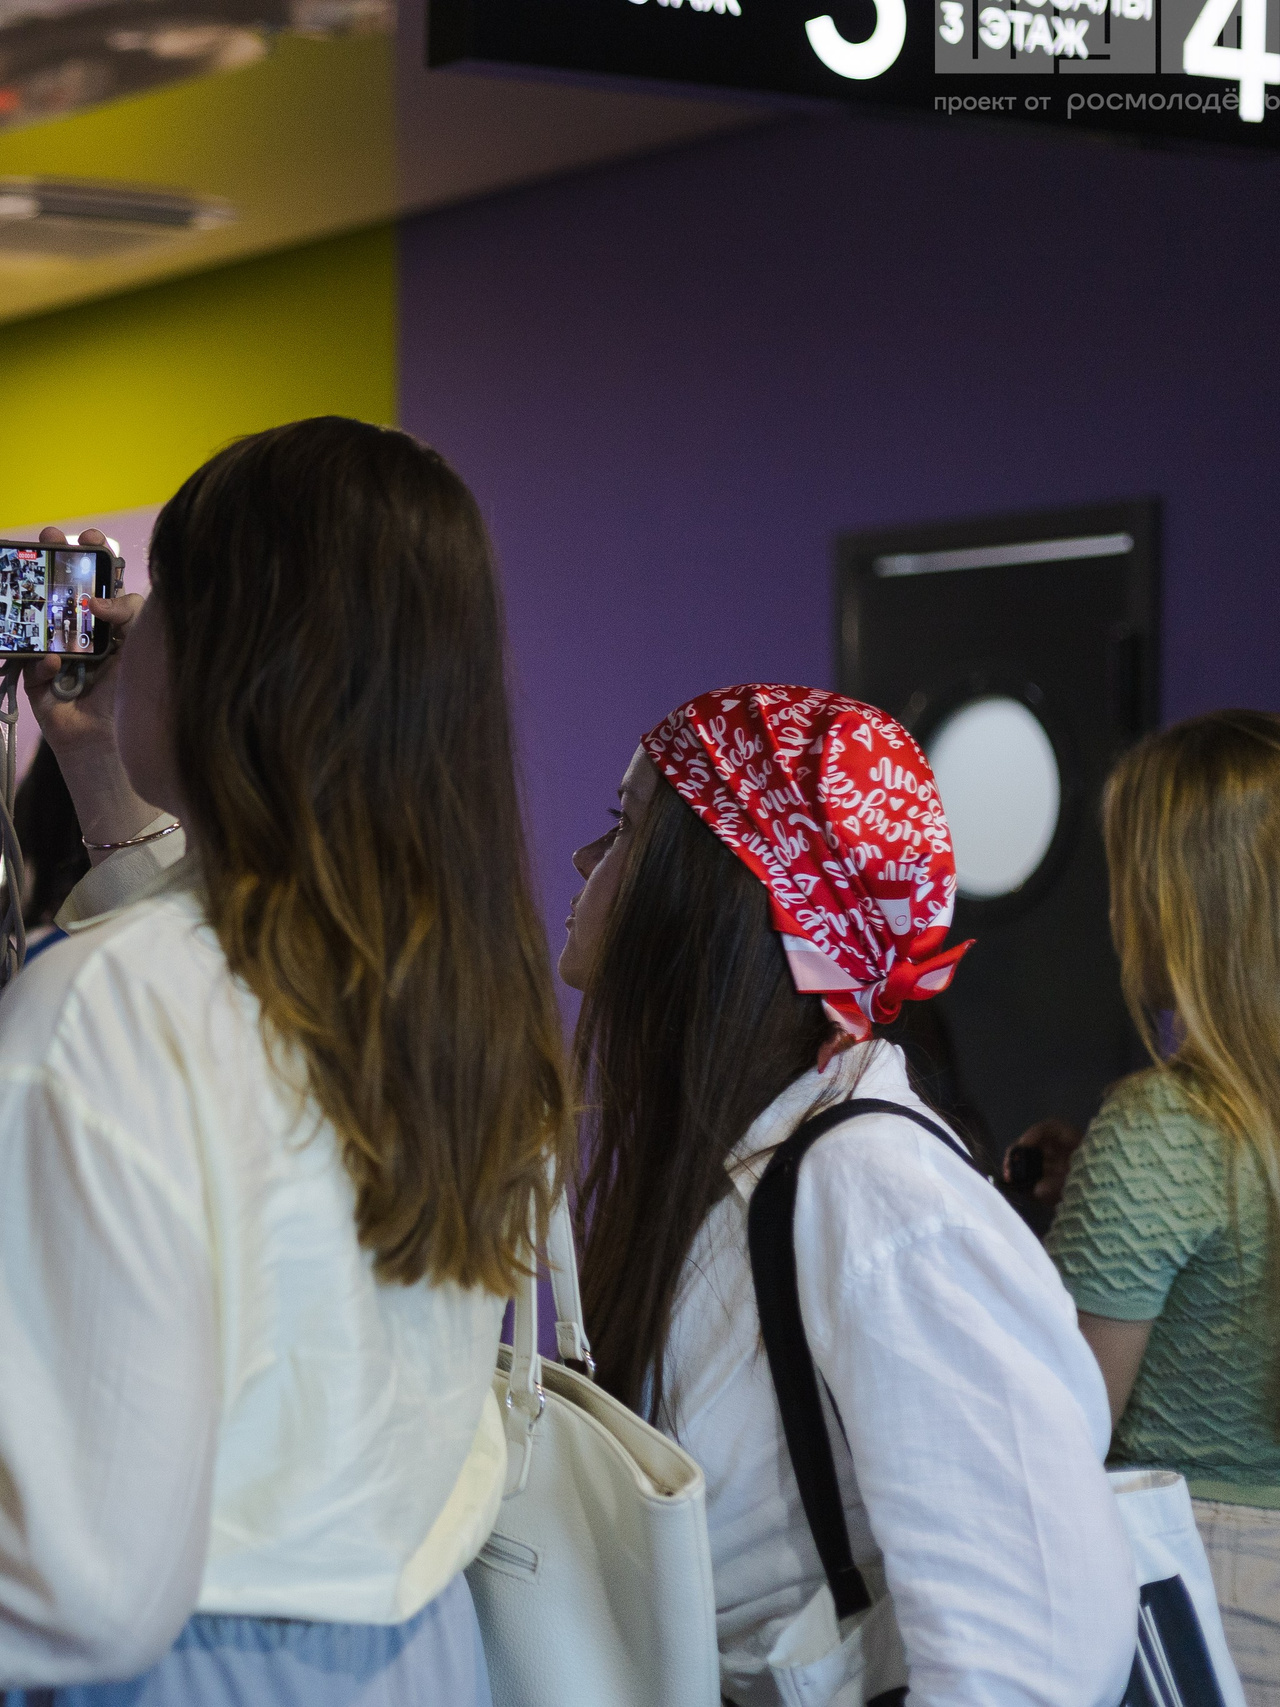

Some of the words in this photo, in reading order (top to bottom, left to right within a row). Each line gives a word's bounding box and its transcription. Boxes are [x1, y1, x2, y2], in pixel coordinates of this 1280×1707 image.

[939, 1, 964, 44] 3
[979, 7, 1090, 60] ЭТАЖ
[1183, 0, 1280, 123] 4
